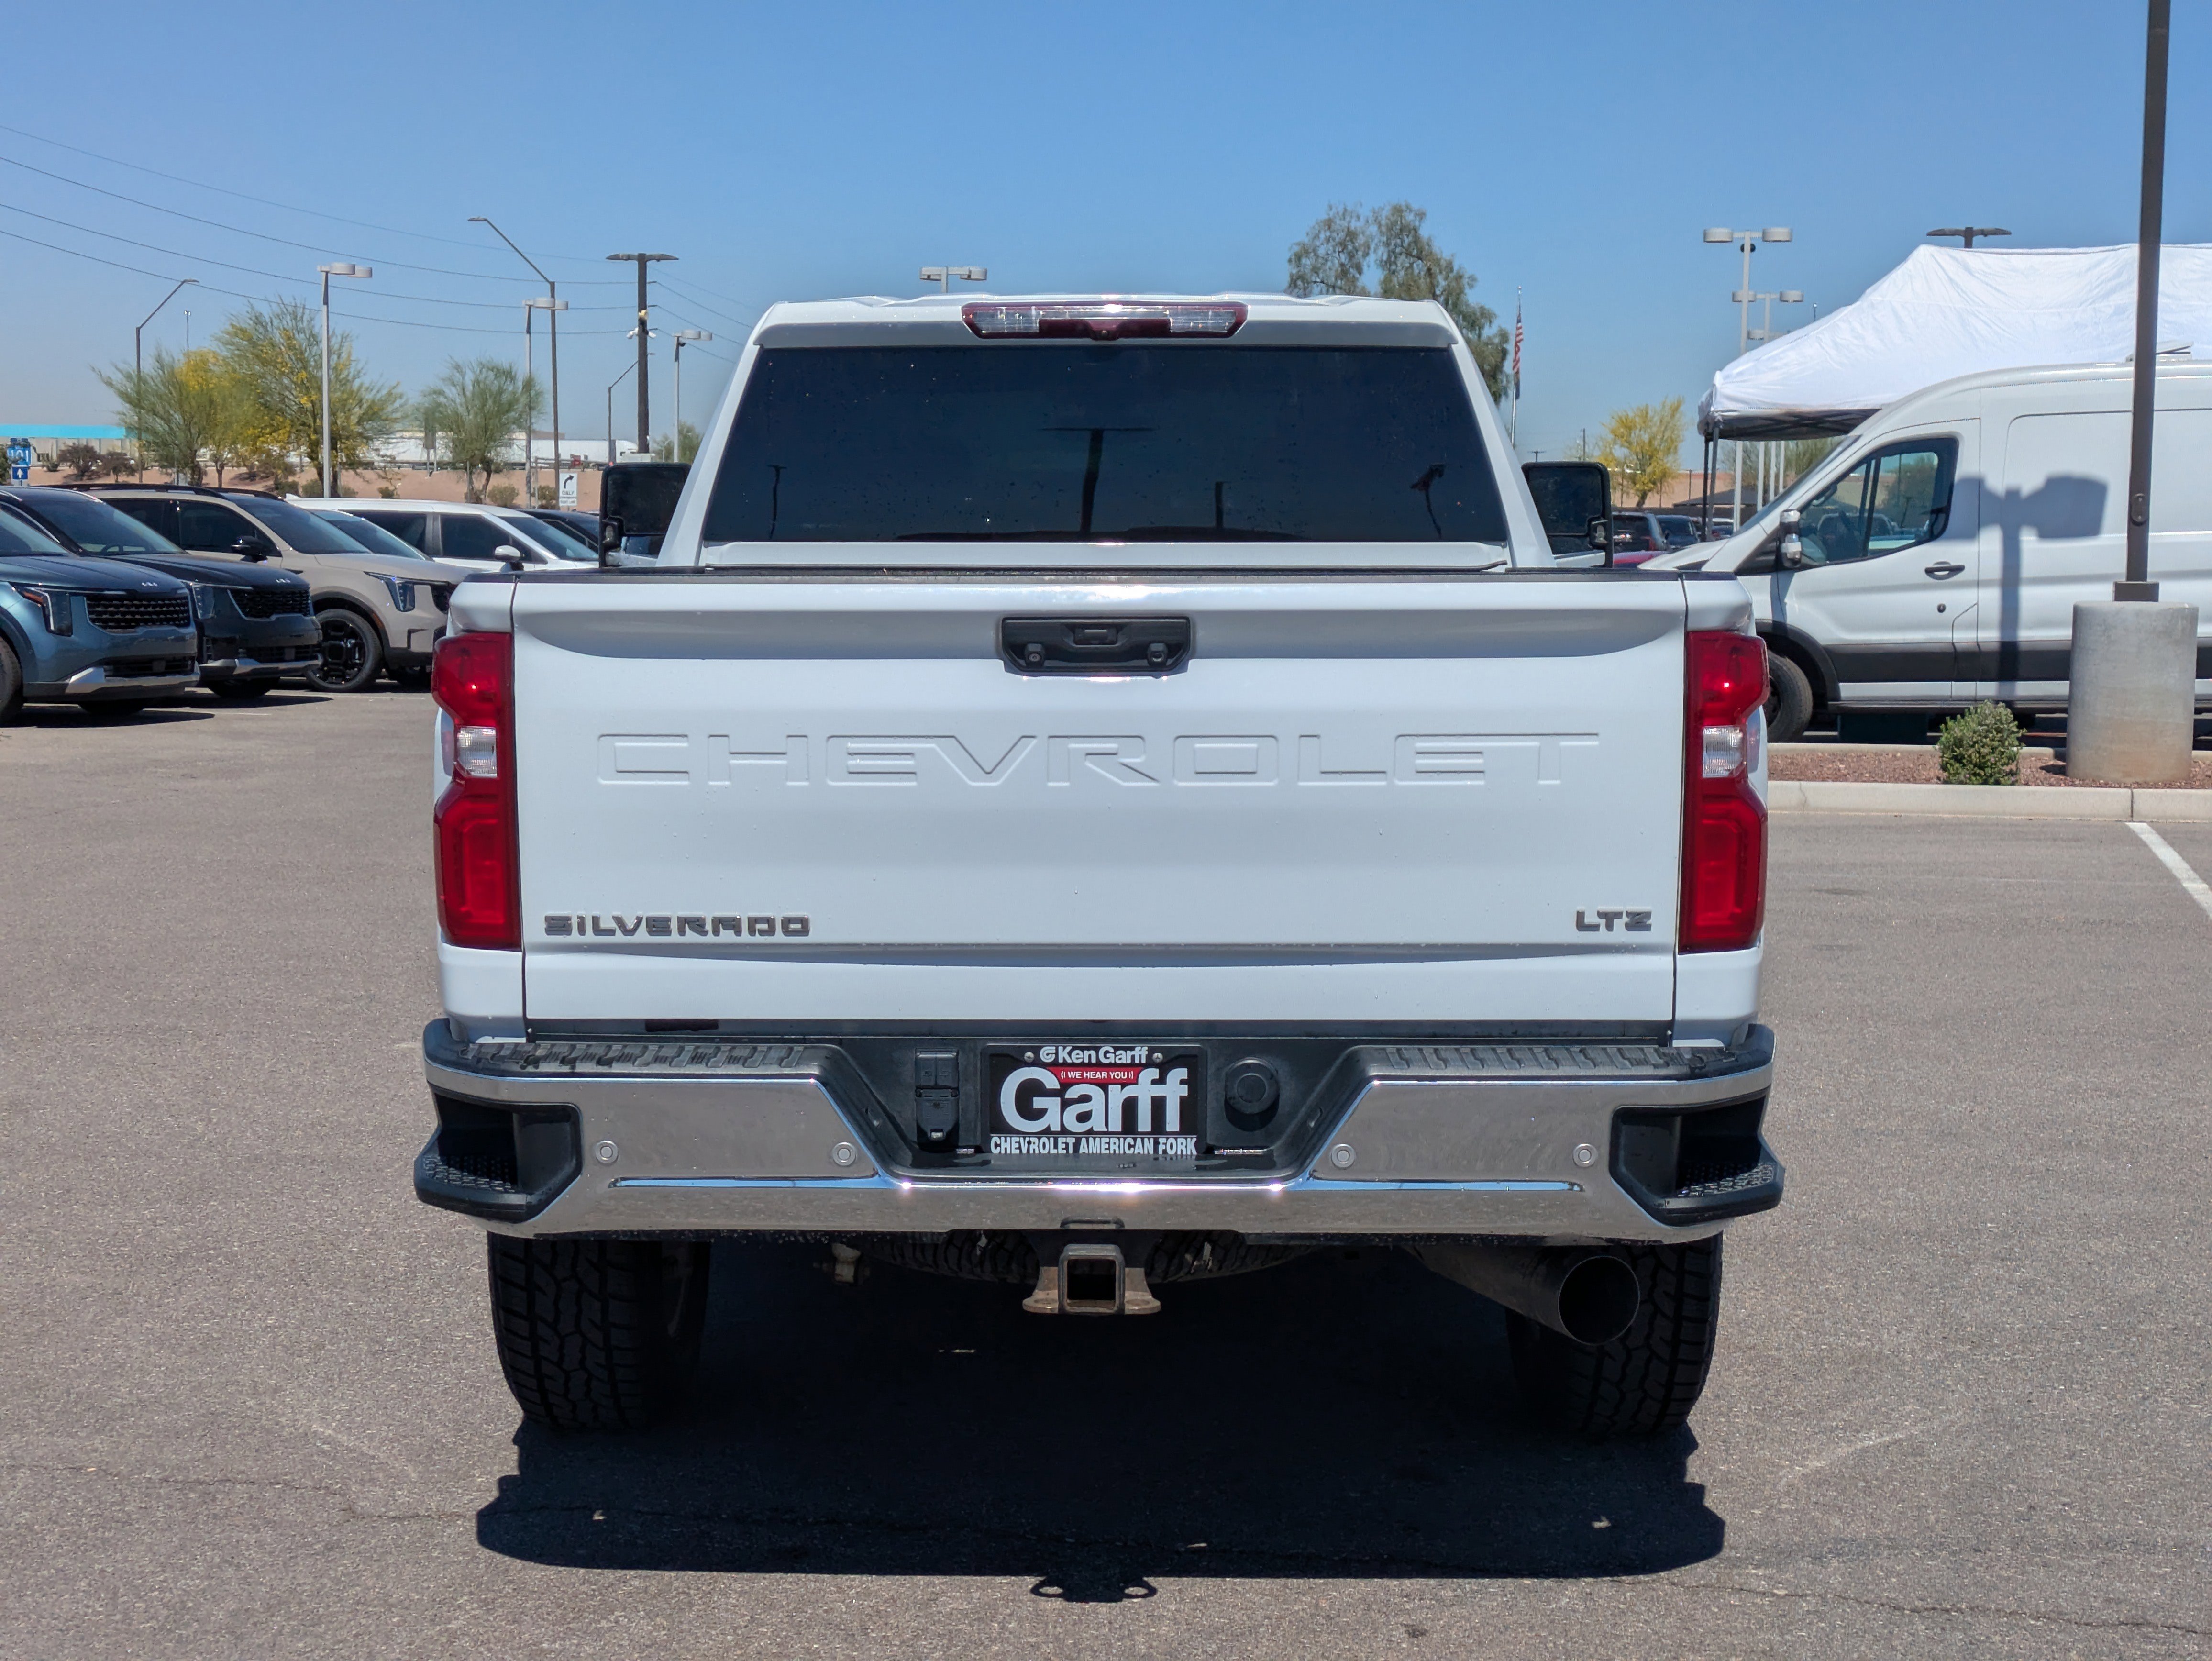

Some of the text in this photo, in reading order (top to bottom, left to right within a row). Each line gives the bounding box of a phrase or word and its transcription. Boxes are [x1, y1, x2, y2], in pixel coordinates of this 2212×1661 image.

[597, 733, 1599, 785] CHEVROLET
[544, 913, 810, 937] SILVERADO
[1576, 909, 1652, 932] LTZ
[1058, 1046, 1096, 1063] Ken
[1098, 1046, 1148, 1063] Garff
[1068, 1071, 1127, 1079] WE HEAR YOU
[1000, 1066, 1188, 1133] Garff
[990, 1136, 1197, 1155] CHEVROLET AMERICAN FORK
